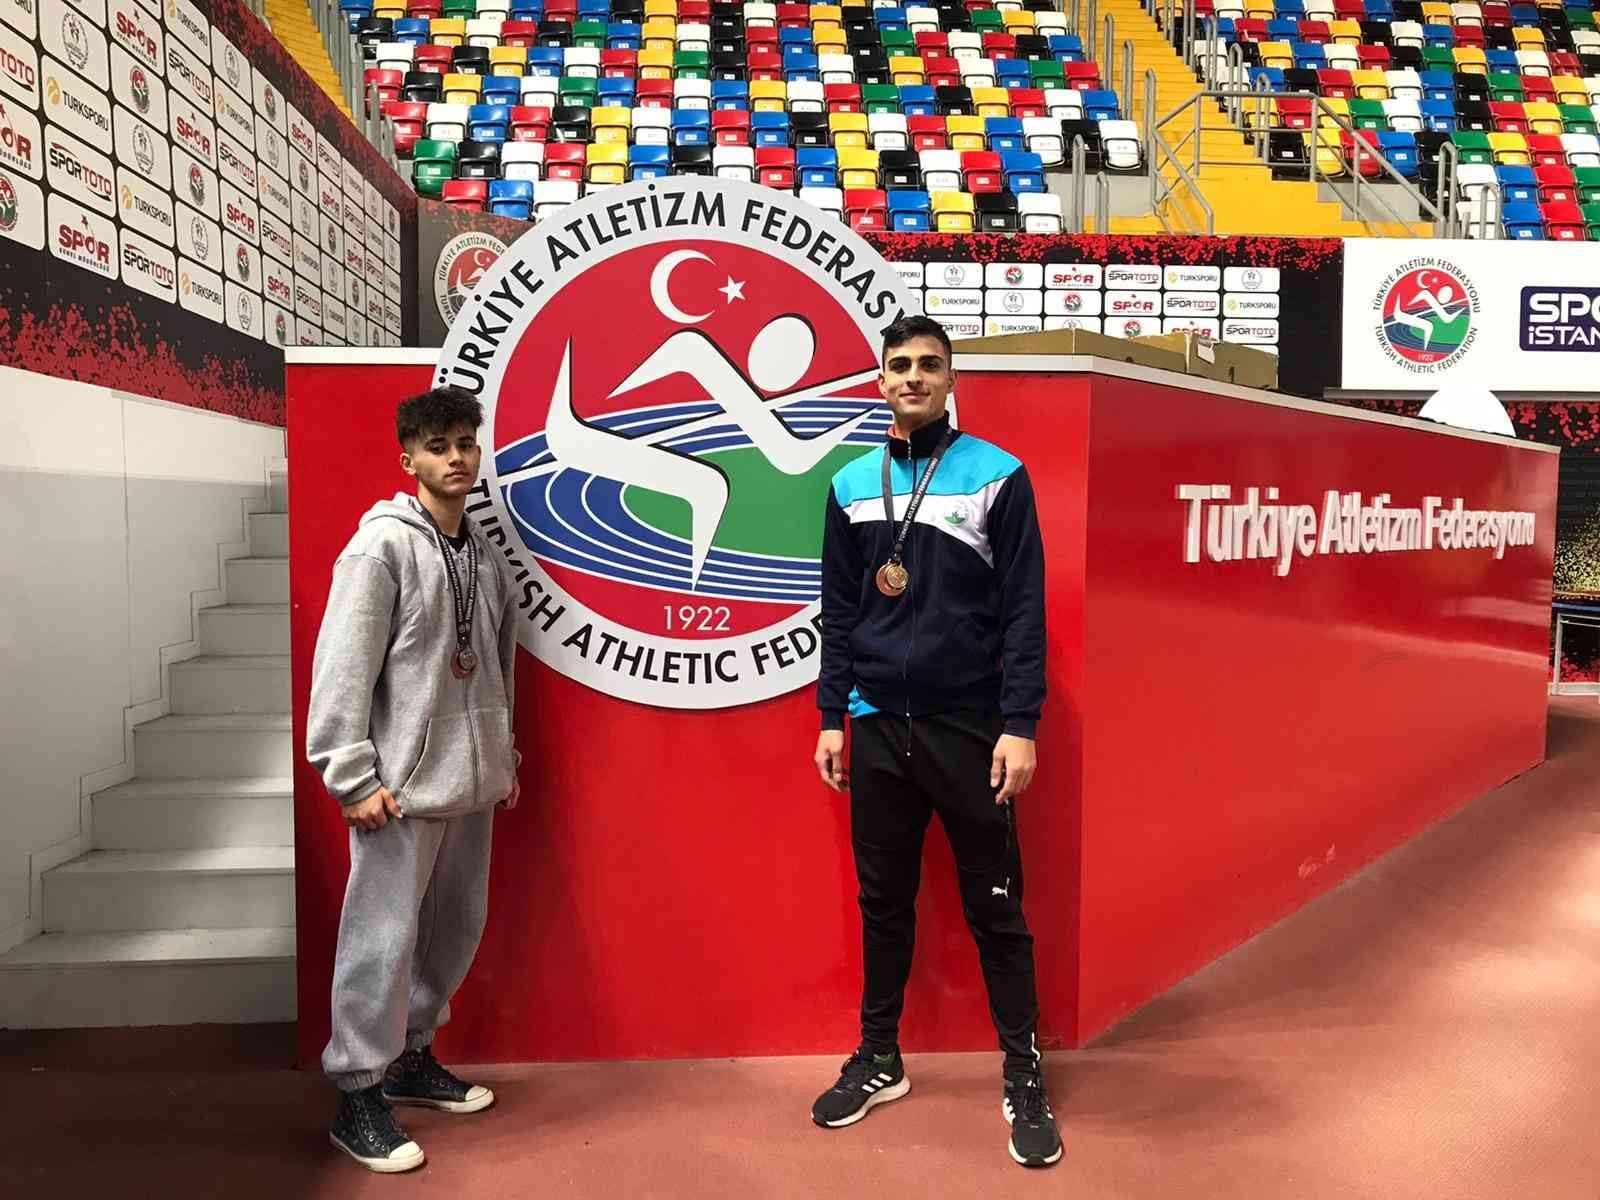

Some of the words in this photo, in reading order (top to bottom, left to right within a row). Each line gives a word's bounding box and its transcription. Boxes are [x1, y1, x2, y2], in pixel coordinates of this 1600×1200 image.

[116, 11, 157, 60] SPOR
[62, 91, 109, 132] TURKSPORU
[176, 116, 211, 155] SPOR
[49, 147, 113, 197] SPORTOTO
[134, 196, 172, 228] TURKSPORU
[226, 202, 255, 235] SPOR
[58, 224, 110, 265] SPOR
[123, 248, 174, 285] SPORTOTO
[1053, 273, 1094, 285] SPOR
[1108, 272, 1159, 282] SPORTOTO
[439, 261, 543, 395] ÜRKİYE
[546, 183, 726, 272] ATLETİZM
[941, 297, 980, 306] TURKSPORU
[1373, 273, 1396, 311] TÜRKİYE
[1395, 257, 1435, 277] ATLETİZM
[1437, 258, 1481, 313] FEDERASYONU
[440, 294, 456, 324] TURKIS
[1112, 300, 1154, 311] SPOR
[1166, 299, 1217, 310] SPORTOTO
[941, 324, 980, 333] ORTOTO
[1225, 327, 1276, 336] SPORTOTO
[1375, 325, 1397, 362] TURKISH
[1396, 357, 1435, 375] ATHLETIC
[1438, 327, 1479, 371] FEDERATION
[1175, 483, 1317, 577] Türkiye
[1319, 489, 1423, 554] Atletizm
[1422, 495, 1536, 560] Federasyonu
[664, 605, 730, 632] 1922
[562, 624, 739, 684] ATHLETIC
